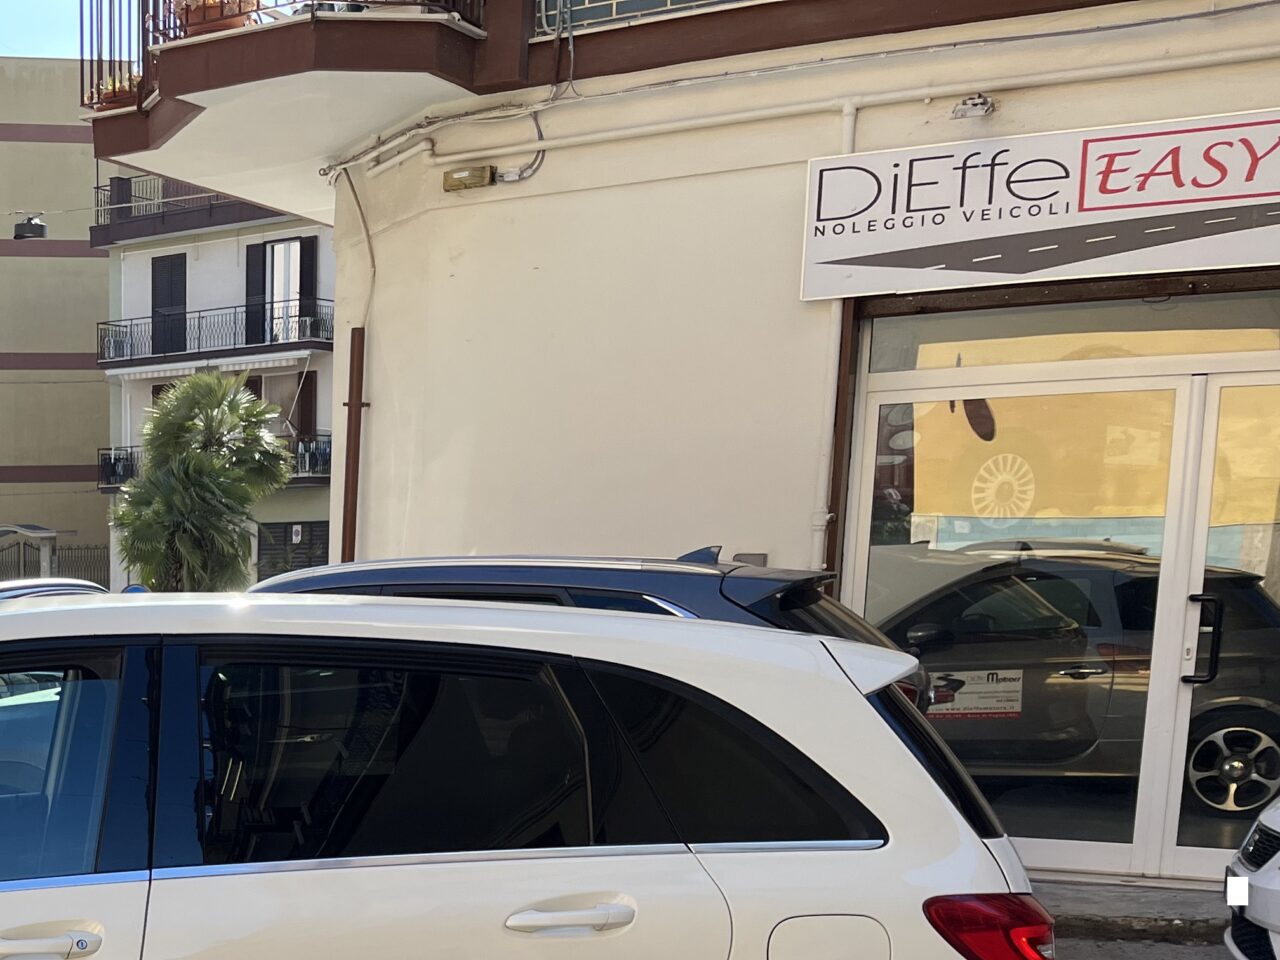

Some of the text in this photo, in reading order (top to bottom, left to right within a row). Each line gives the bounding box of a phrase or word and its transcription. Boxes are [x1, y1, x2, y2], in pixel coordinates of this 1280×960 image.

[816, 136, 1280, 222] DiEffe EASY
[814, 201, 1070, 238] NOLEGGIO VEICOLI
